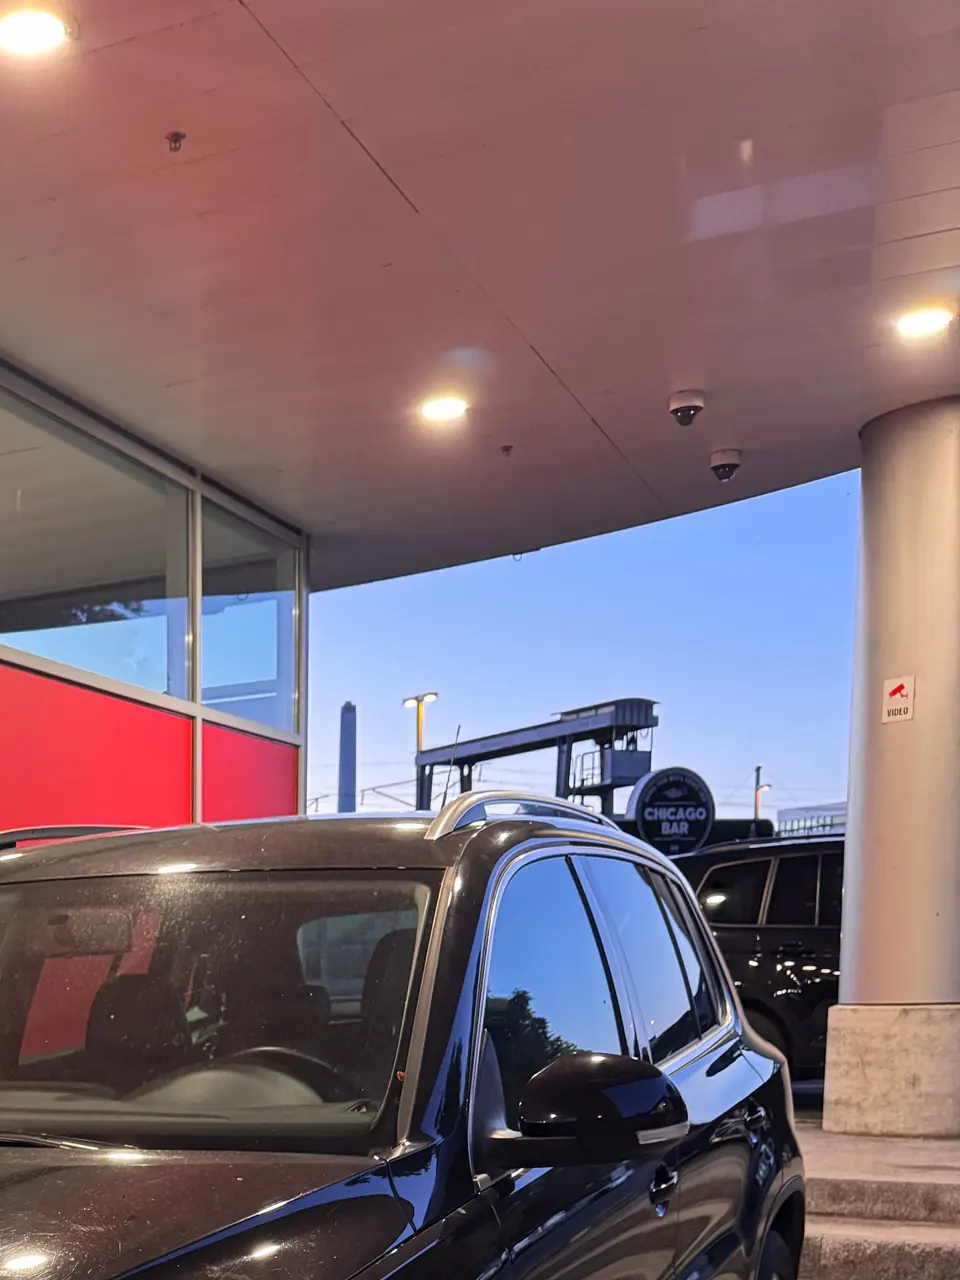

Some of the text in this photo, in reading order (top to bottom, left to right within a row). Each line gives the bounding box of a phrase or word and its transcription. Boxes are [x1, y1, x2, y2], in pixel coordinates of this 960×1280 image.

[887, 707, 909, 717] VIDEO
[644, 807, 707, 820] CHICAGO
[661, 821, 689, 835] BAR
